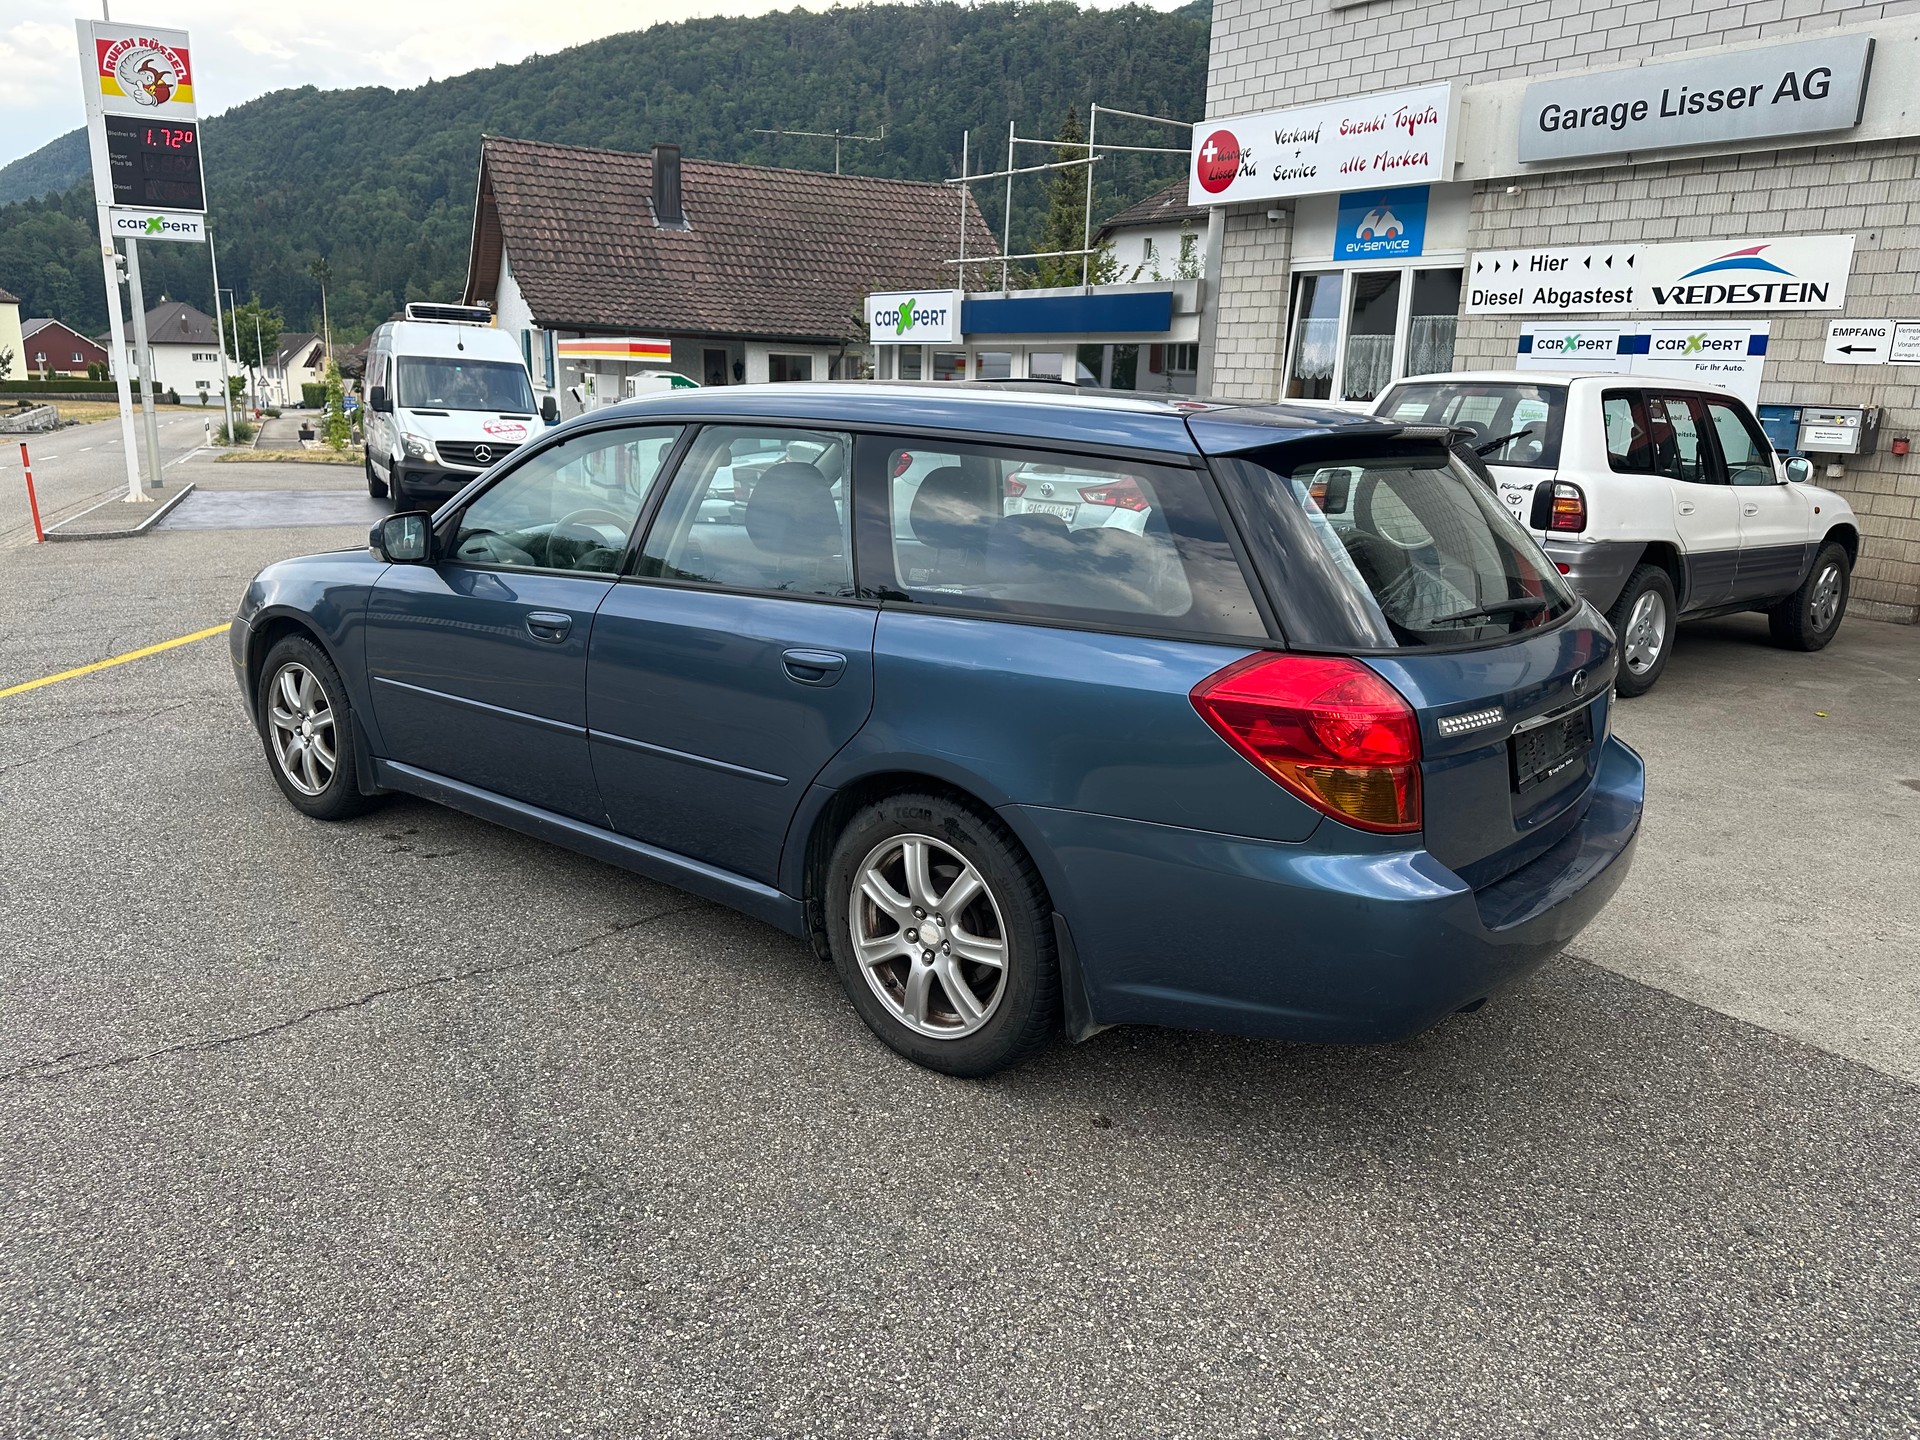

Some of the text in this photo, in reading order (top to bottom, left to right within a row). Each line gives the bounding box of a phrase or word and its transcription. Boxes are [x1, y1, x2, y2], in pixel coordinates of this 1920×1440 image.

[106, 37, 186, 78] RUEDI RÜSSEL
[1539, 67, 1832, 132] Garage Lisser AG
[1339, 104, 1438, 136] Suzuki Toyota
[107, 129, 129, 137] Bleifrei
[1274, 121, 1323, 145] Verkauf
[110, 152, 128, 160] Super
[1217, 147, 1251, 164] Garage
[1339, 149, 1428, 174] alle Marken
[1208, 161, 1258, 181] Lisser AG
[1272, 163, 1317, 181] Service
[1345, 239, 1410, 253] ev-service
[1530, 255, 1568, 272] Hier
[1471, 286, 1634, 308] Diesel Abgastest
[1652, 282, 1830, 305] VREDESTEIN
[1832, 327, 1886, 337] EMPFANG
[1695, 363, 1745, 372] Für Ihr Auto.
[936, 587, 963, 595] AWD
